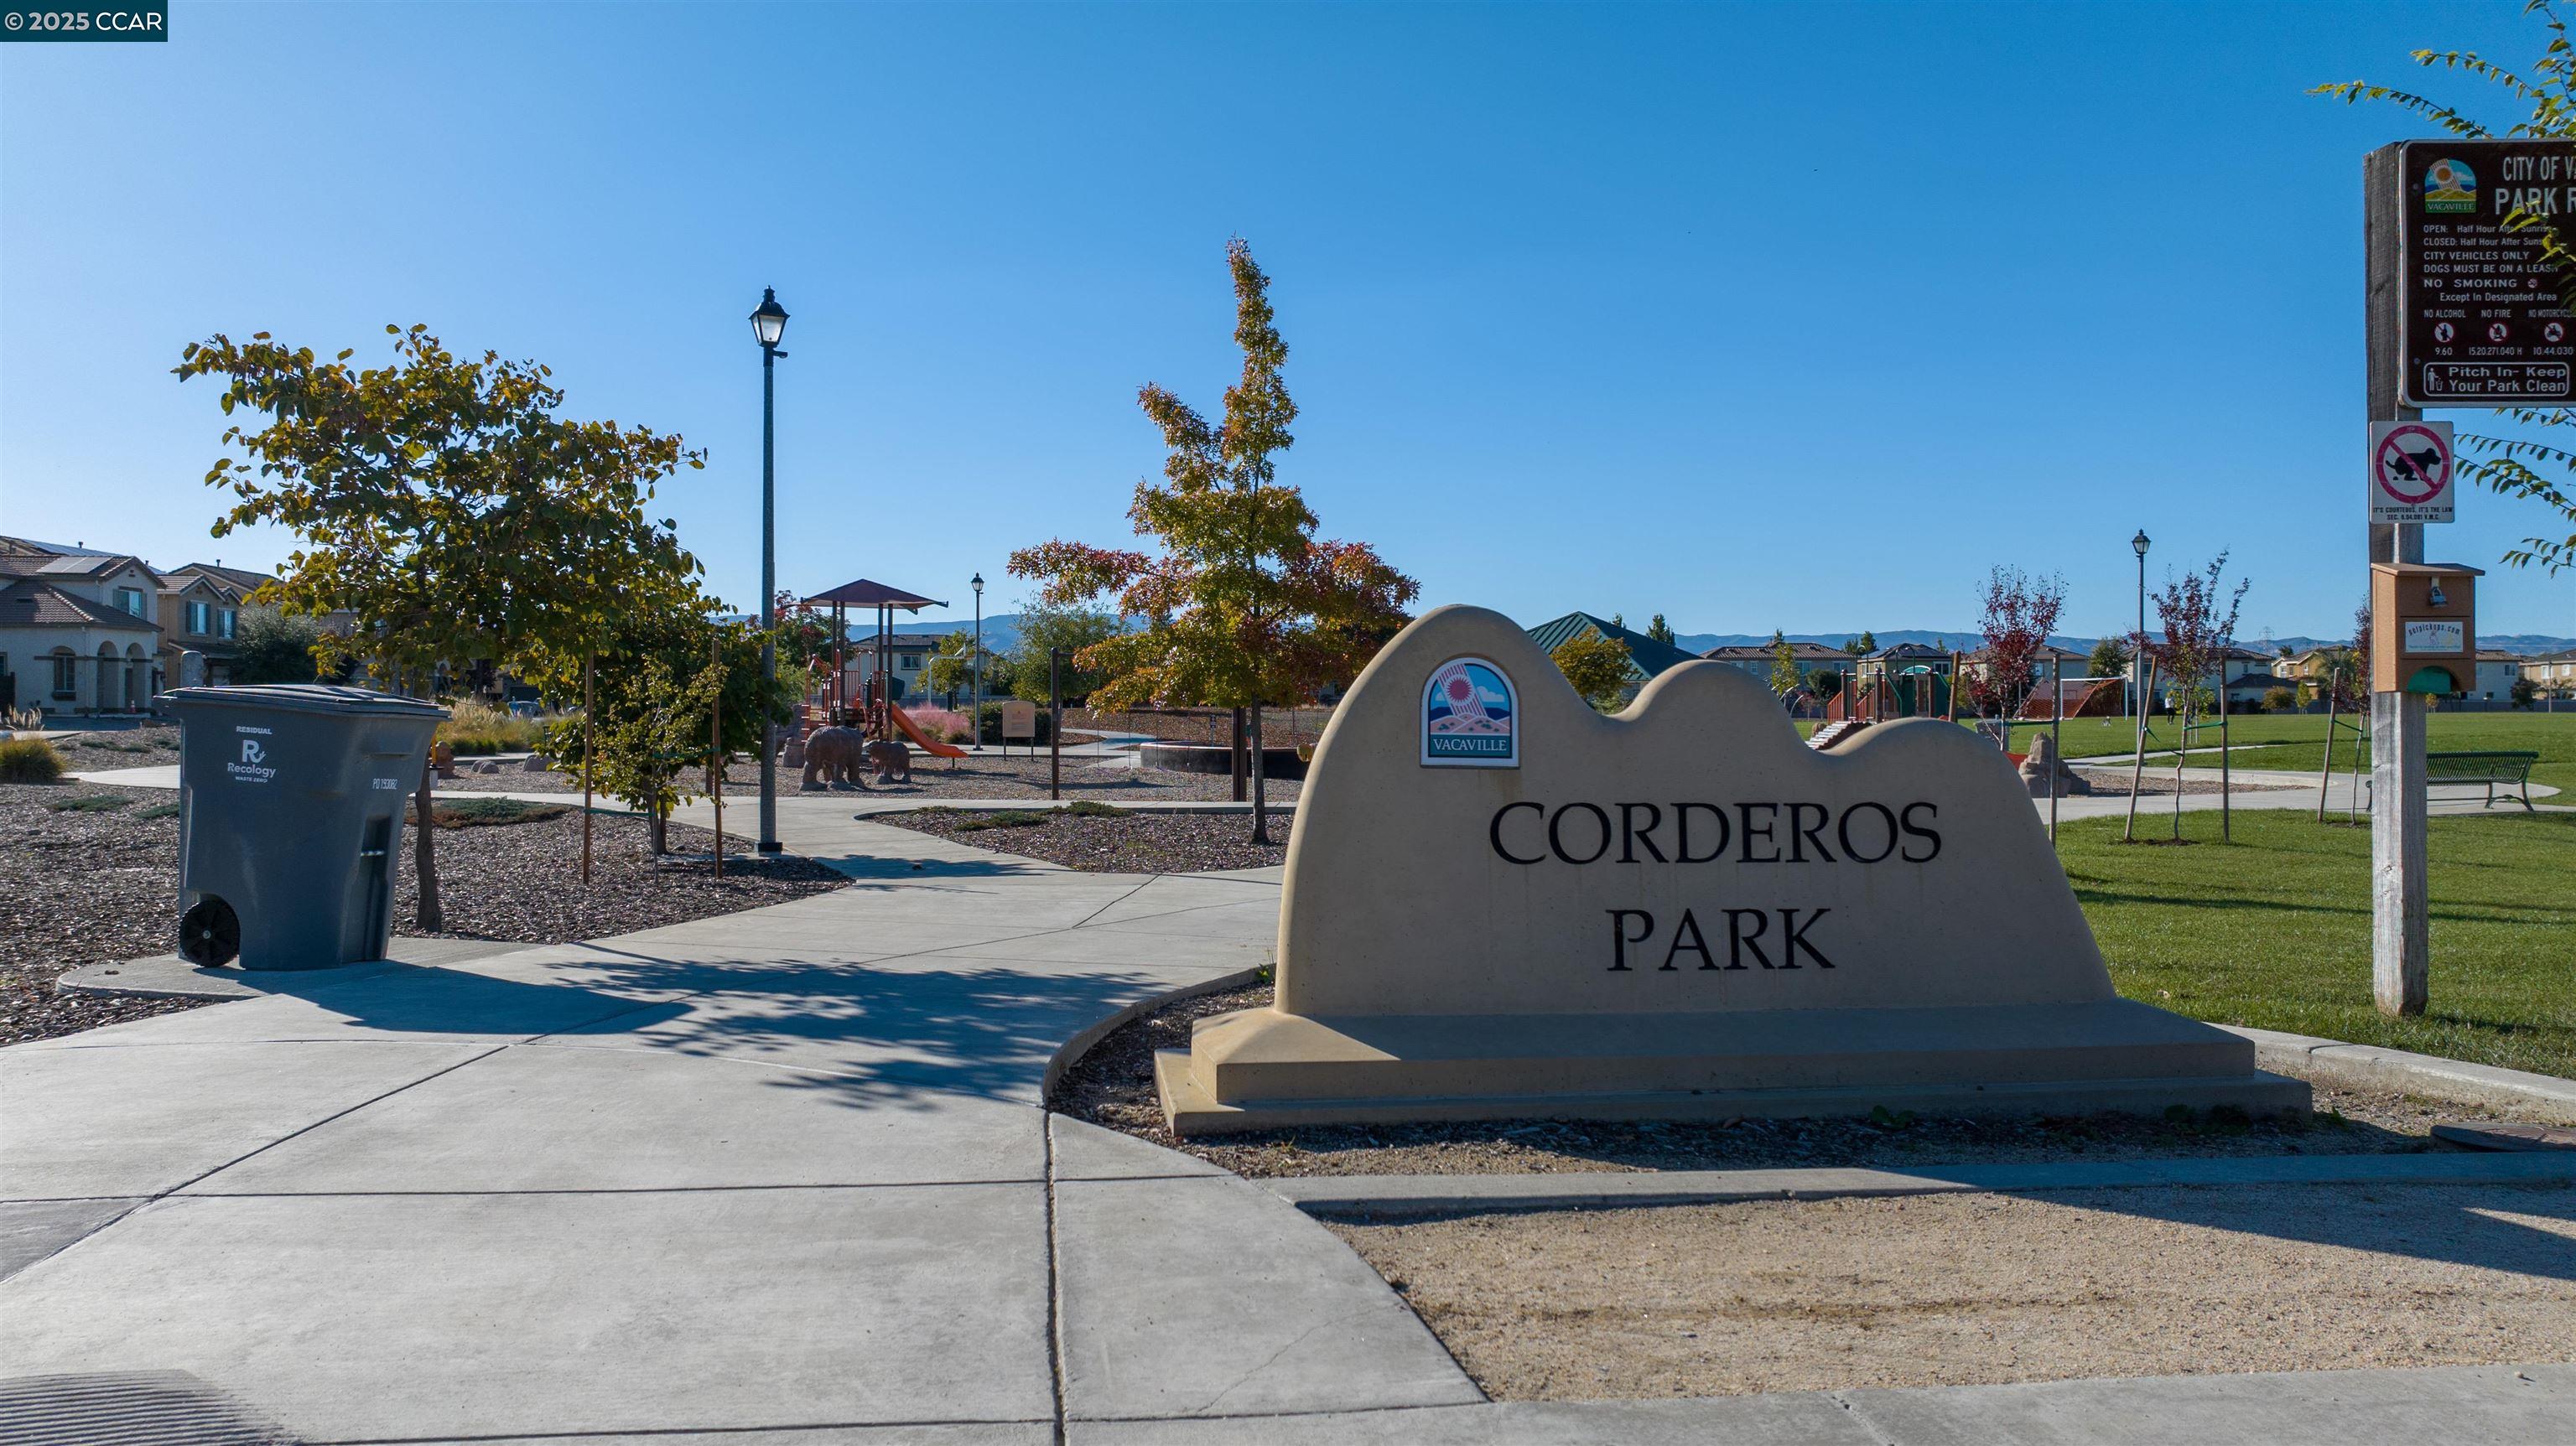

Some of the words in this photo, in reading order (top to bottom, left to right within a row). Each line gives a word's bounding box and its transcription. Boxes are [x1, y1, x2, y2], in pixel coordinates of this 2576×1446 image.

[2503, 156, 2535, 181] CITY
[2540, 156, 2560, 181] OF
[2495, 188, 2558, 215] PARK
[2423, 225, 2449, 233] OPEN:
[2457, 225, 2475, 233] Half
[2476, 225, 2496, 233] Hour
[2423, 237, 2458, 246] CLOSED:
[2460, 237, 2477, 246] Half
[2479, 237, 2498, 246] Hour
[2501, 238, 2521, 246] After
[2423, 251, 2445, 261] CITY
[2449, 251, 2499, 261] VEHICLES
[2502, 251, 2530, 261] ONLY
[2423, 264, 2450, 273] DOGS
[2454, 264, 2480, 273] MUST
[2483, 264, 2496, 273] BE
[2499, 264, 2513, 273] ON
[2516, 264, 2523, 273] A
[2423, 278, 2443, 288] NO
[2454, 278, 2517, 288] SMOKING
[2440, 293, 2470, 303] Except
[2473, 293, 2482, 302] In
[2485, 293, 2534, 303] Designated
[2537, 293, 2558, 302] Area
[2423, 309, 2433, 318] NO
[2435, 309, 2466, 319] ALCOHOL
[2481, 309, 2492, 318] NO
[2495, 309, 2511, 318] FIRE
[2528, 309, 2537, 318] NO
[2435, 346, 2454, 355] 9.60
[2533, 346, 2573, 355] 10.44.030
[2449, 366, 2490, 376] Pitch
[2497, 366, 2520, 376] In-
[2526, 366, 2566, 379] Keep
[2449, 380, 2482, 391] Your
[2488, 380, 2521, 391] Park
[2526, 380, 2566, 392] Clean
[236, 725, 273, 734] RESIDUAL
[1432, 739, 1507, 751] VACAVILLE
[227, 762, 276, 779] Recology
[1489, 801, 1942, 865] CORDEROS
[1605, 908, 1836, 972] PARK
